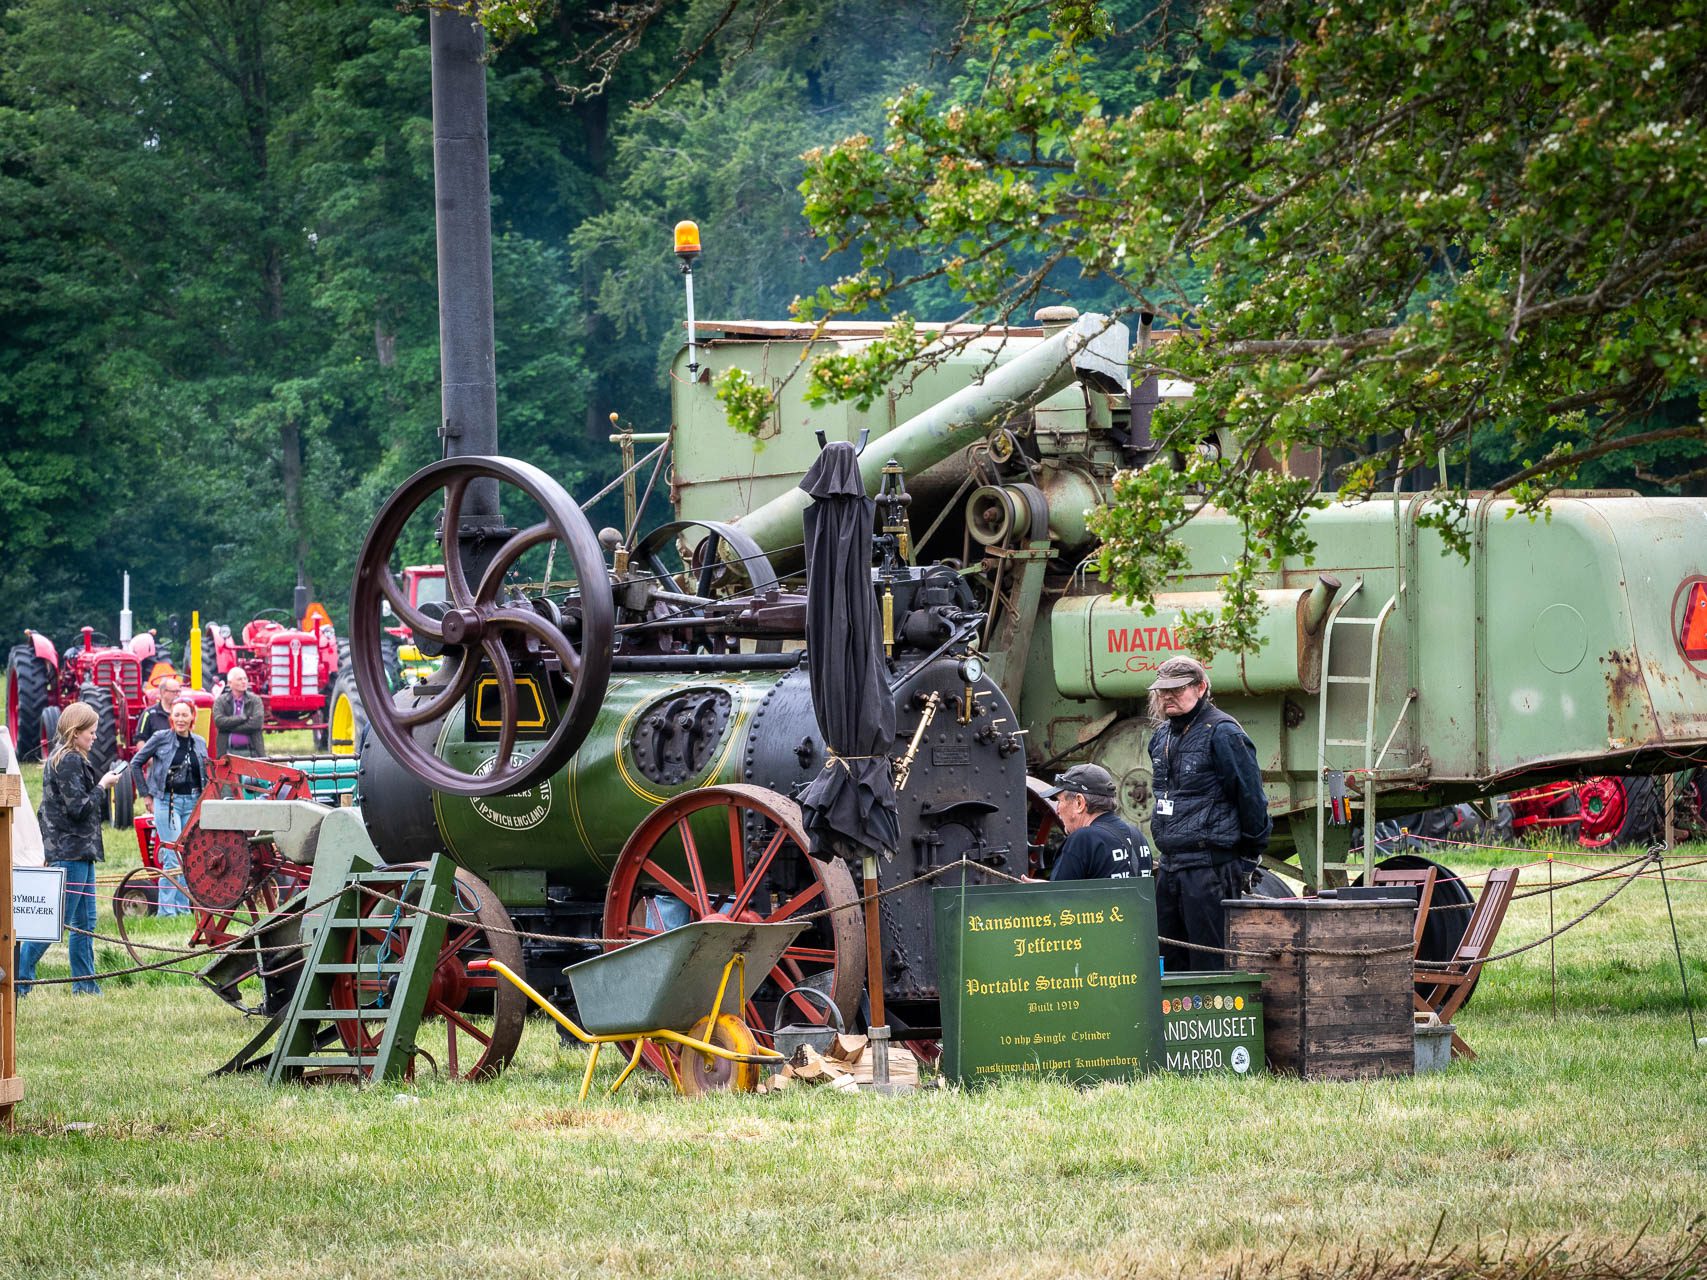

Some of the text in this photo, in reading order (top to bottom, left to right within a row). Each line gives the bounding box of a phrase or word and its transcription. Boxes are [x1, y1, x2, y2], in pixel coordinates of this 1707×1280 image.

[479, 803, 547, 827] IPSWICH ENGLAND.
[968, 906, 1125, 931] Ransomes, Sims &
[1013, 936, 1083, 957] Jefferies
[965, 971, 1138, 996] Portable Steam Engine
[1027, 1000, 1080, 1014] Built 1919
[1000, 1036, 1012, 1045] 10
[1033, 1032, 1067, 1046] Single
[1071, 1030, 1111, 1043] Cylinder
[975, 1062, 1021, 1074] maskinen
